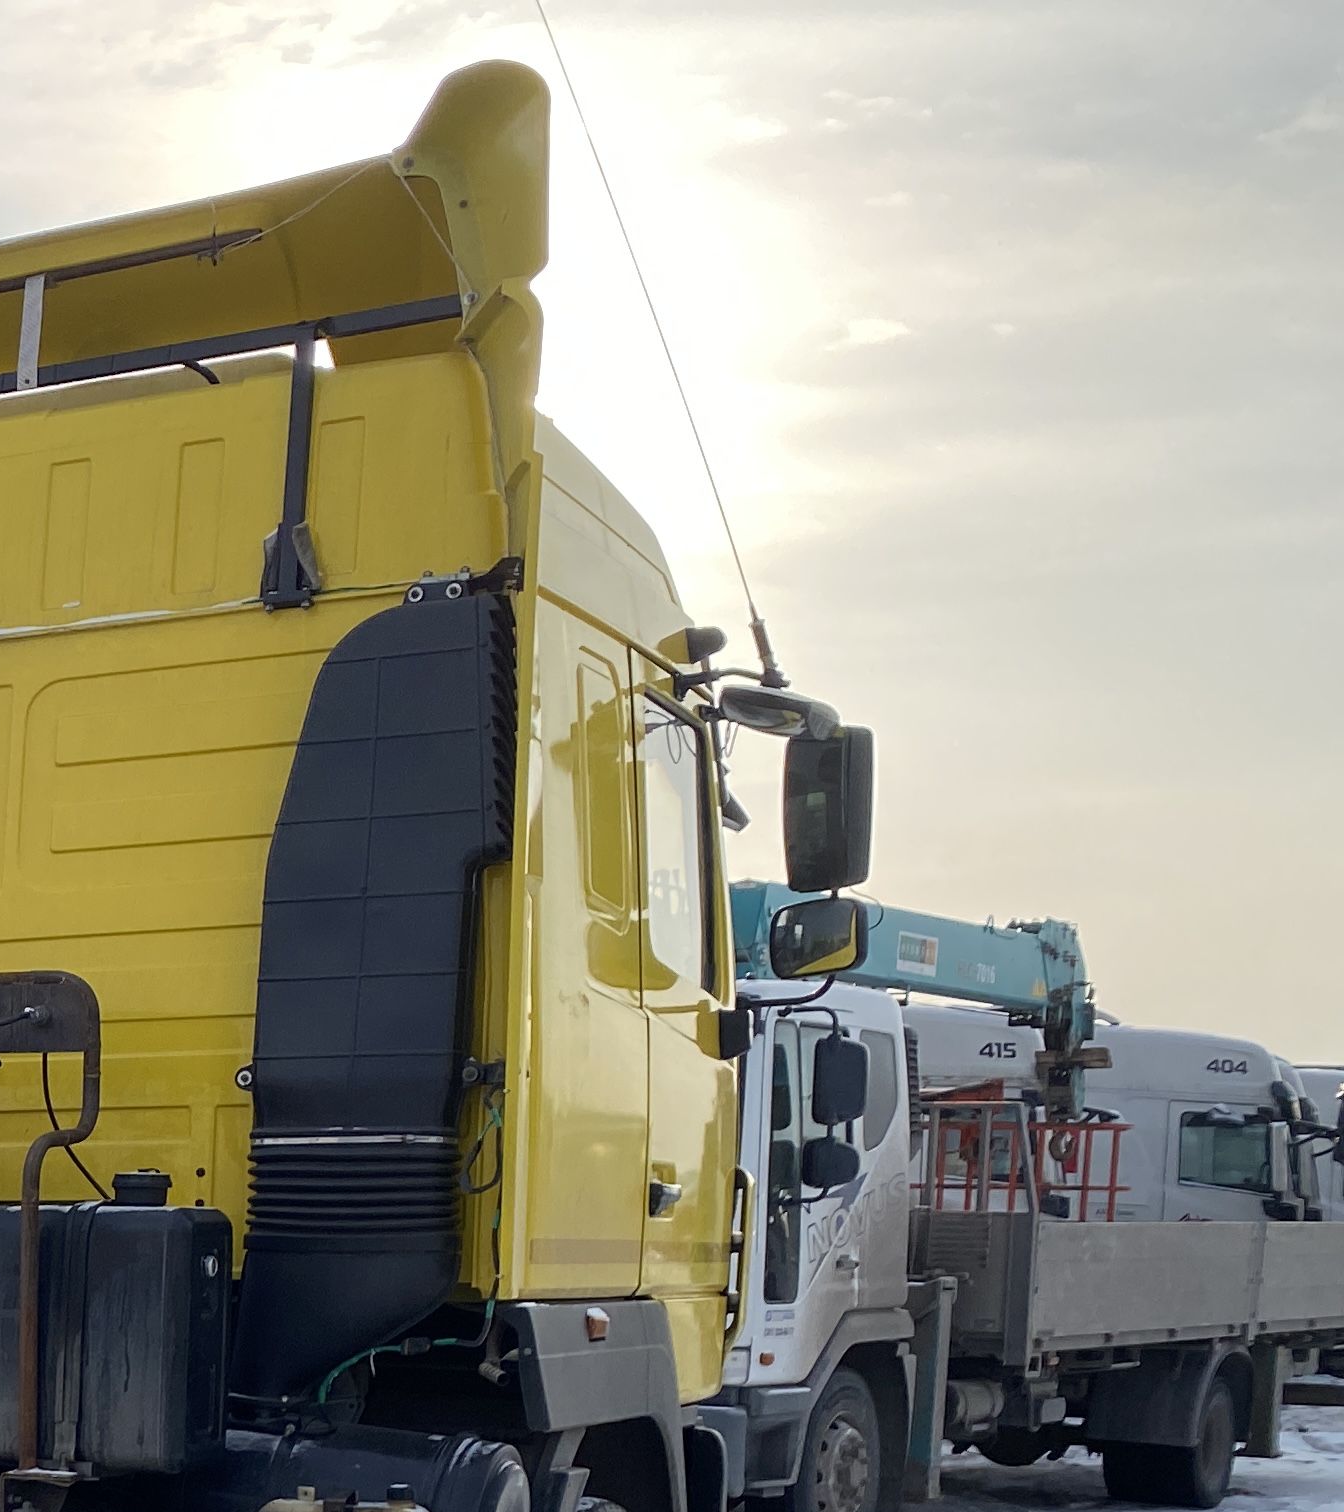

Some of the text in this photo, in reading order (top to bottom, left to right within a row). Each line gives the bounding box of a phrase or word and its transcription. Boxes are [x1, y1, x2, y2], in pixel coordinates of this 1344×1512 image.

[978, 1042, 1017, 1059] 415
[1206, 1058, 1249, 1075] 404
[806, 1171, 907, 1264] NOVUS
